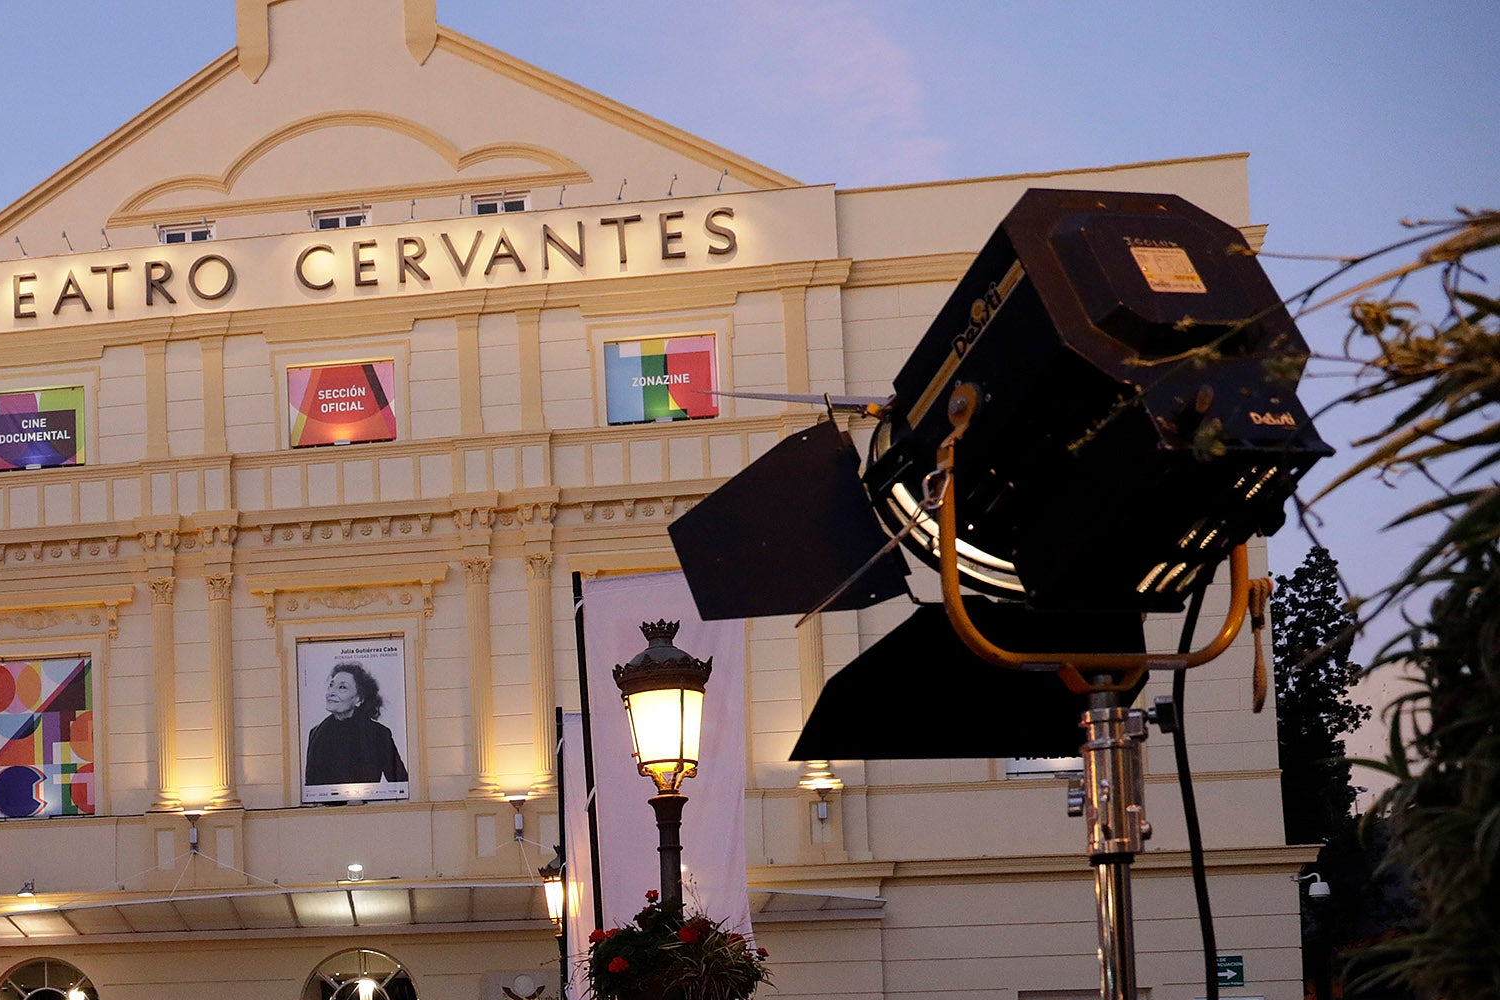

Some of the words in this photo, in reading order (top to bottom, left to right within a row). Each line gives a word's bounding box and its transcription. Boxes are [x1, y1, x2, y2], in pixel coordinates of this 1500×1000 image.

[298, 207, 737, 290] CERVANTES
[631, 373, 690, 387] ZONAZINE
[318, 385, 366, 399] SECCIÓN
[320, 401, 364, 413] OFICIAL
[21, 418, 47, 429] CINE
